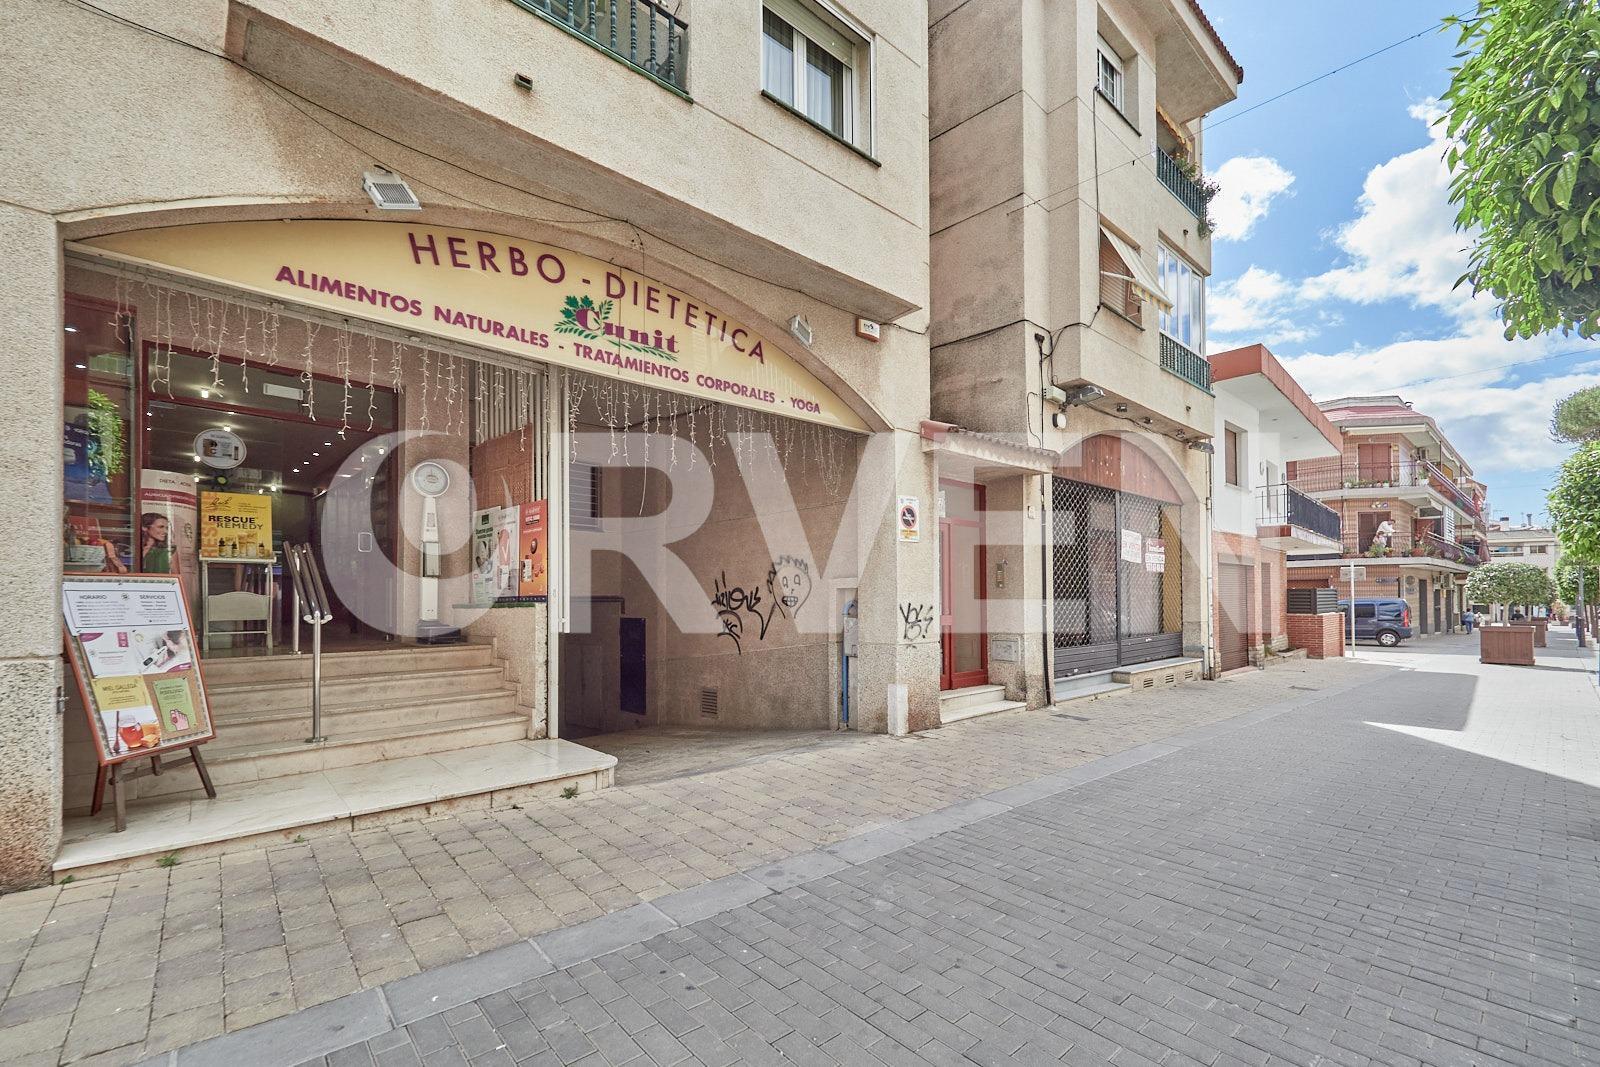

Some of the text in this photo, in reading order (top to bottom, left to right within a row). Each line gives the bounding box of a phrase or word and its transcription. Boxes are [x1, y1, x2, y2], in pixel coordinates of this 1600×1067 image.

[408, 232, 566, 284] HERBO
[606, 271, 765, 364] DIETETICA
[275, 265, 422, 317] ALIMENTOS
[434, 305, 549, 349] NATURALES
[573, 342, 690, 383] TRATAMIENTOS
[696, 374, 775, 404] CORPORALES
[790, 396, 821, 414] YOGA
[575, 307, 680, 354] Cunit
[208, 515, 255, 524] RESCUE
[216, 522, 263, 530] REMEDY
